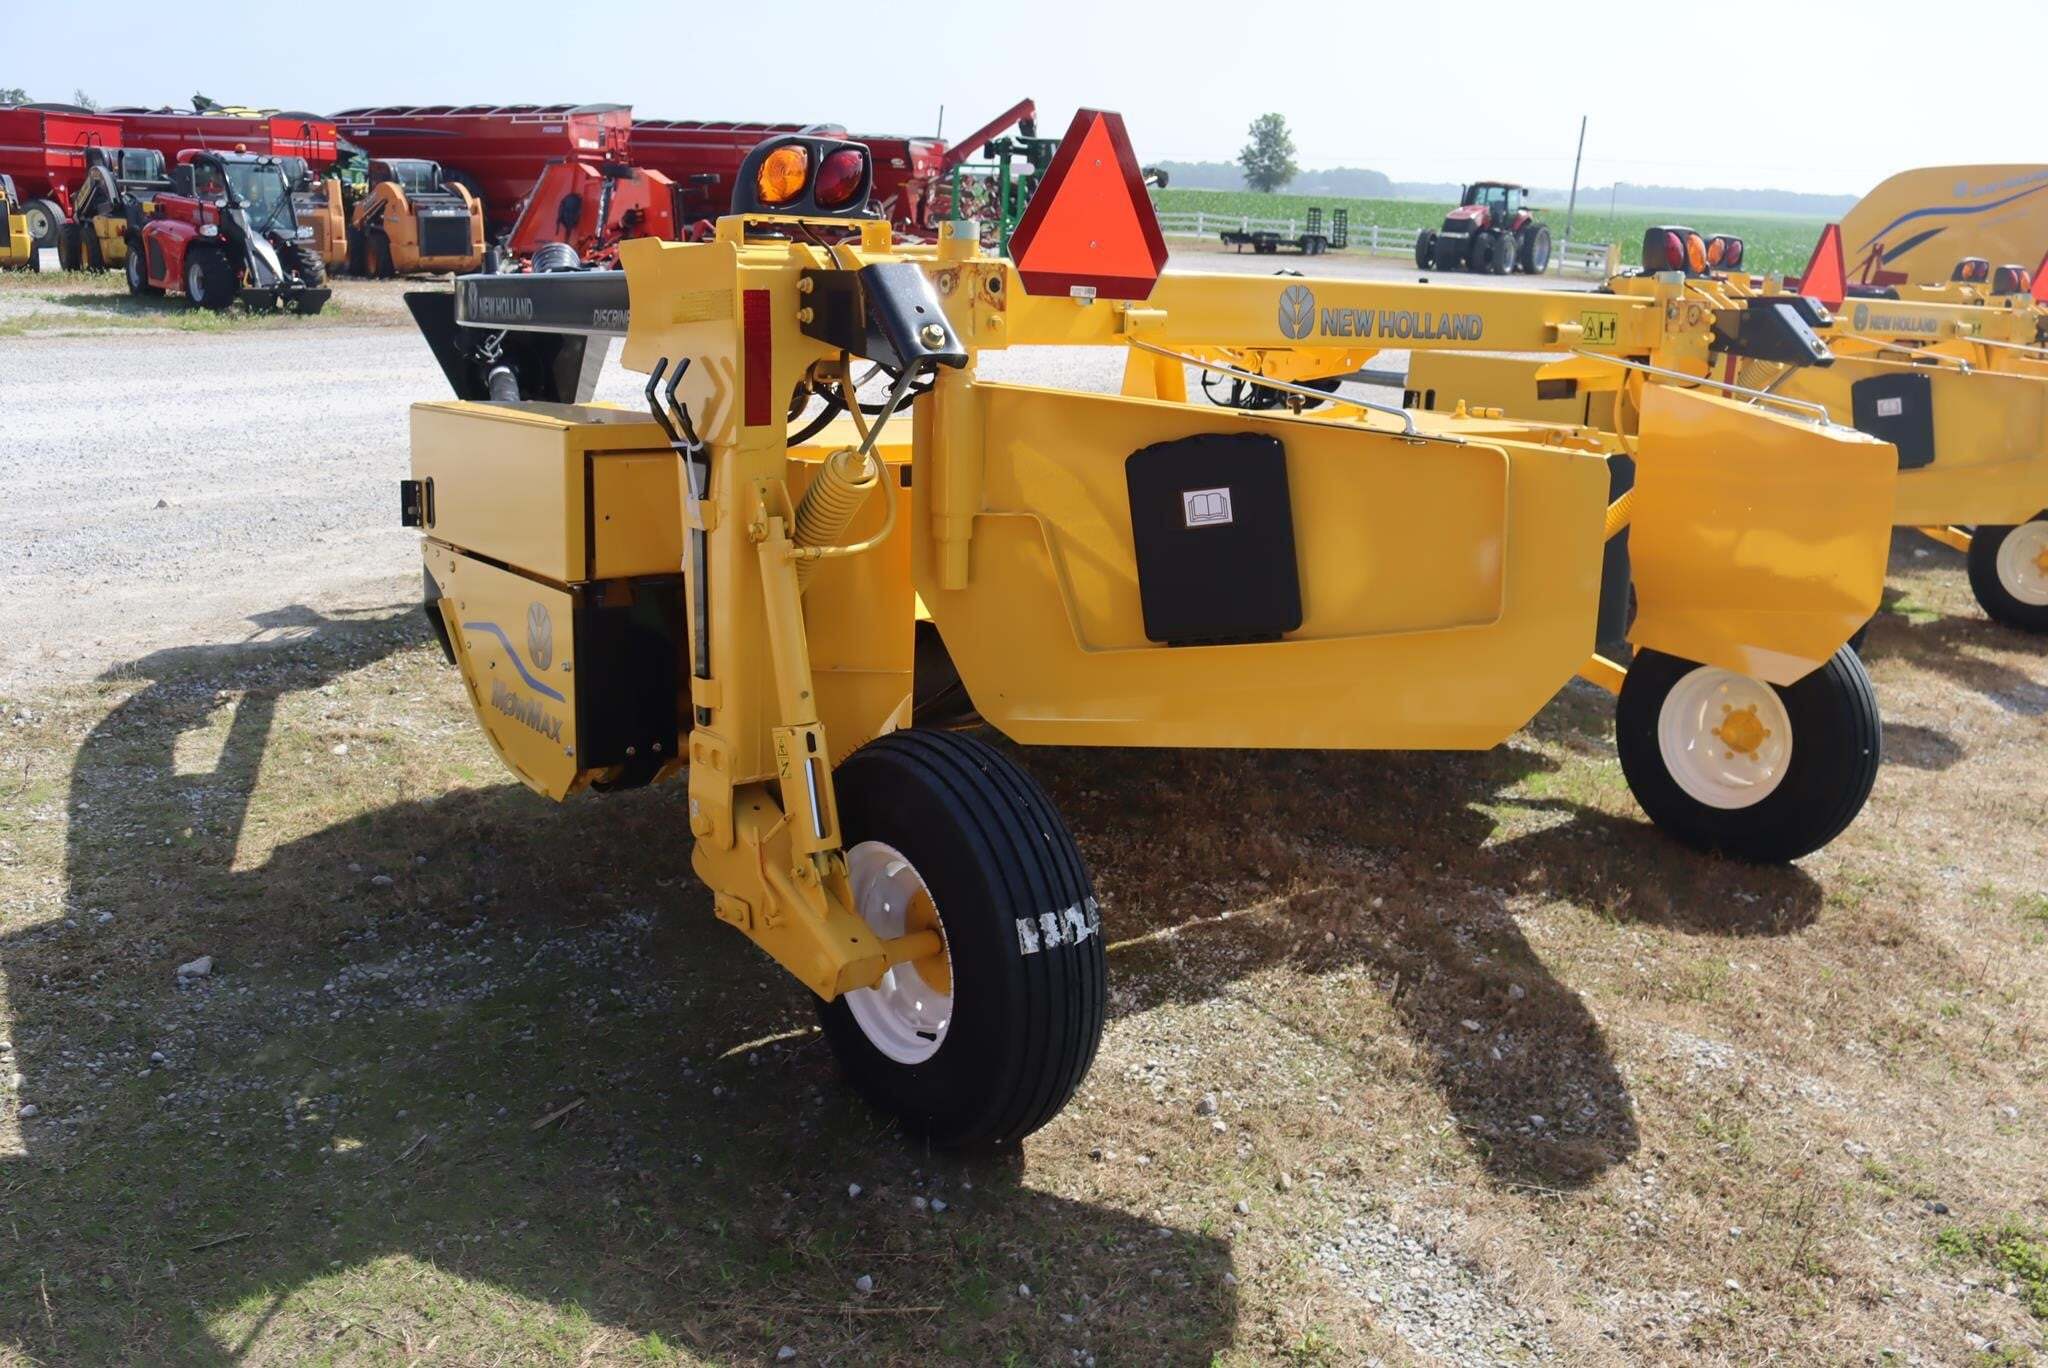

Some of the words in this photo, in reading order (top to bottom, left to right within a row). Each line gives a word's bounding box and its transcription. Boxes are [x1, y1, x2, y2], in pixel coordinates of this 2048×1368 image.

[479, 296, 495, 319] NEW
[495, 296, 534, 320] HOLLAND
[1320, 308, 1375, 337] NEW
[1379, 310, 1483, 340] HOLLAND
[1870, 315, 1891, 331] NEW
[1892, 316, 1937, 332] HOLLAND
